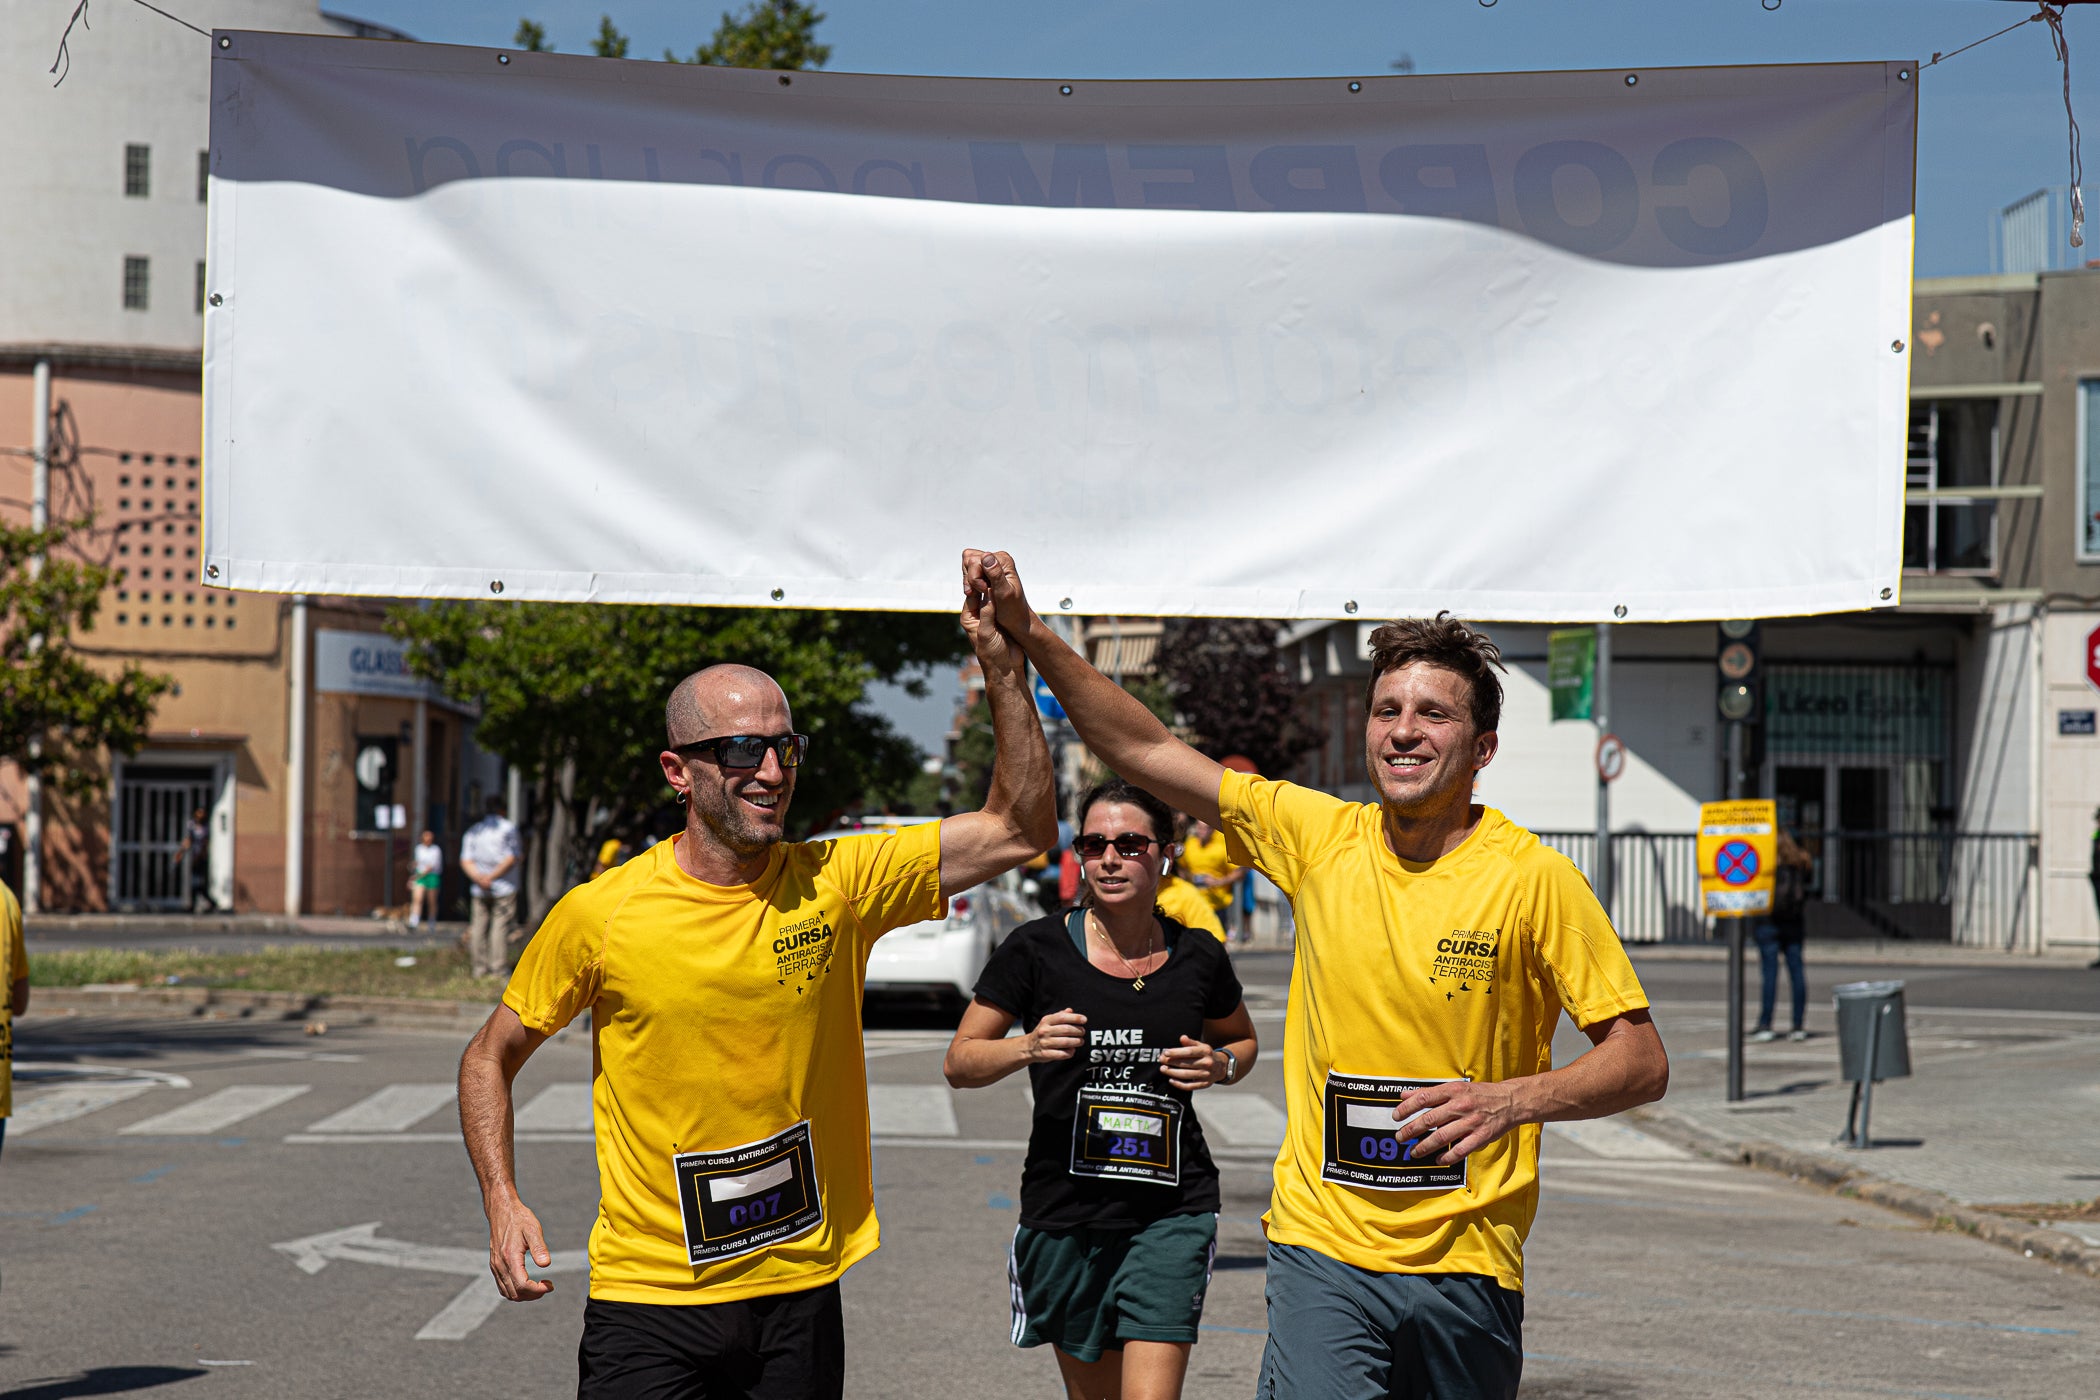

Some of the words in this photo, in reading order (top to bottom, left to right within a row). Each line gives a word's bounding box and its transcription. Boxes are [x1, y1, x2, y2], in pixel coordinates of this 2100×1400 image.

[350, 646, 410, 675] GLASS
[778, 915, 822, 937] PRIMERA
[772, 923, 833, 955] CURSA
[1451, 929, 1495, 942] PRIMERA
[1436, 938, 1498, 958] CURSA
[777, 948, 835, 977] TERRASSA
[1432, 964, 1496, 982] TERRASS
[1090, 1029, 1144, 1046] FAKE
[1086, 1066, 1135, 1080] TRUE
[1347, 1082, 1375, 1092] CURSA
[1102, 1115, 1151, 1132] MARTA
[1109, 1136, 1152, 1158] 251
[1360, 1136, 1420, 1161] 097
[680, 1159, 707, 1169] PRIMERA
[707, 1156, 735, 1166] CURSA
[1095, 1164, 1118, 1173] CURSA
[1326, 1167, 1350, 1176] PRIMERA
[1350, 1171, 1374, 1182] CURSA
[1429, 1174, 1462, 1182] TERRASSA
[693, 1246, 720, 1256] PRIMERA
[720, 1238, 748, 1252] CURSA
